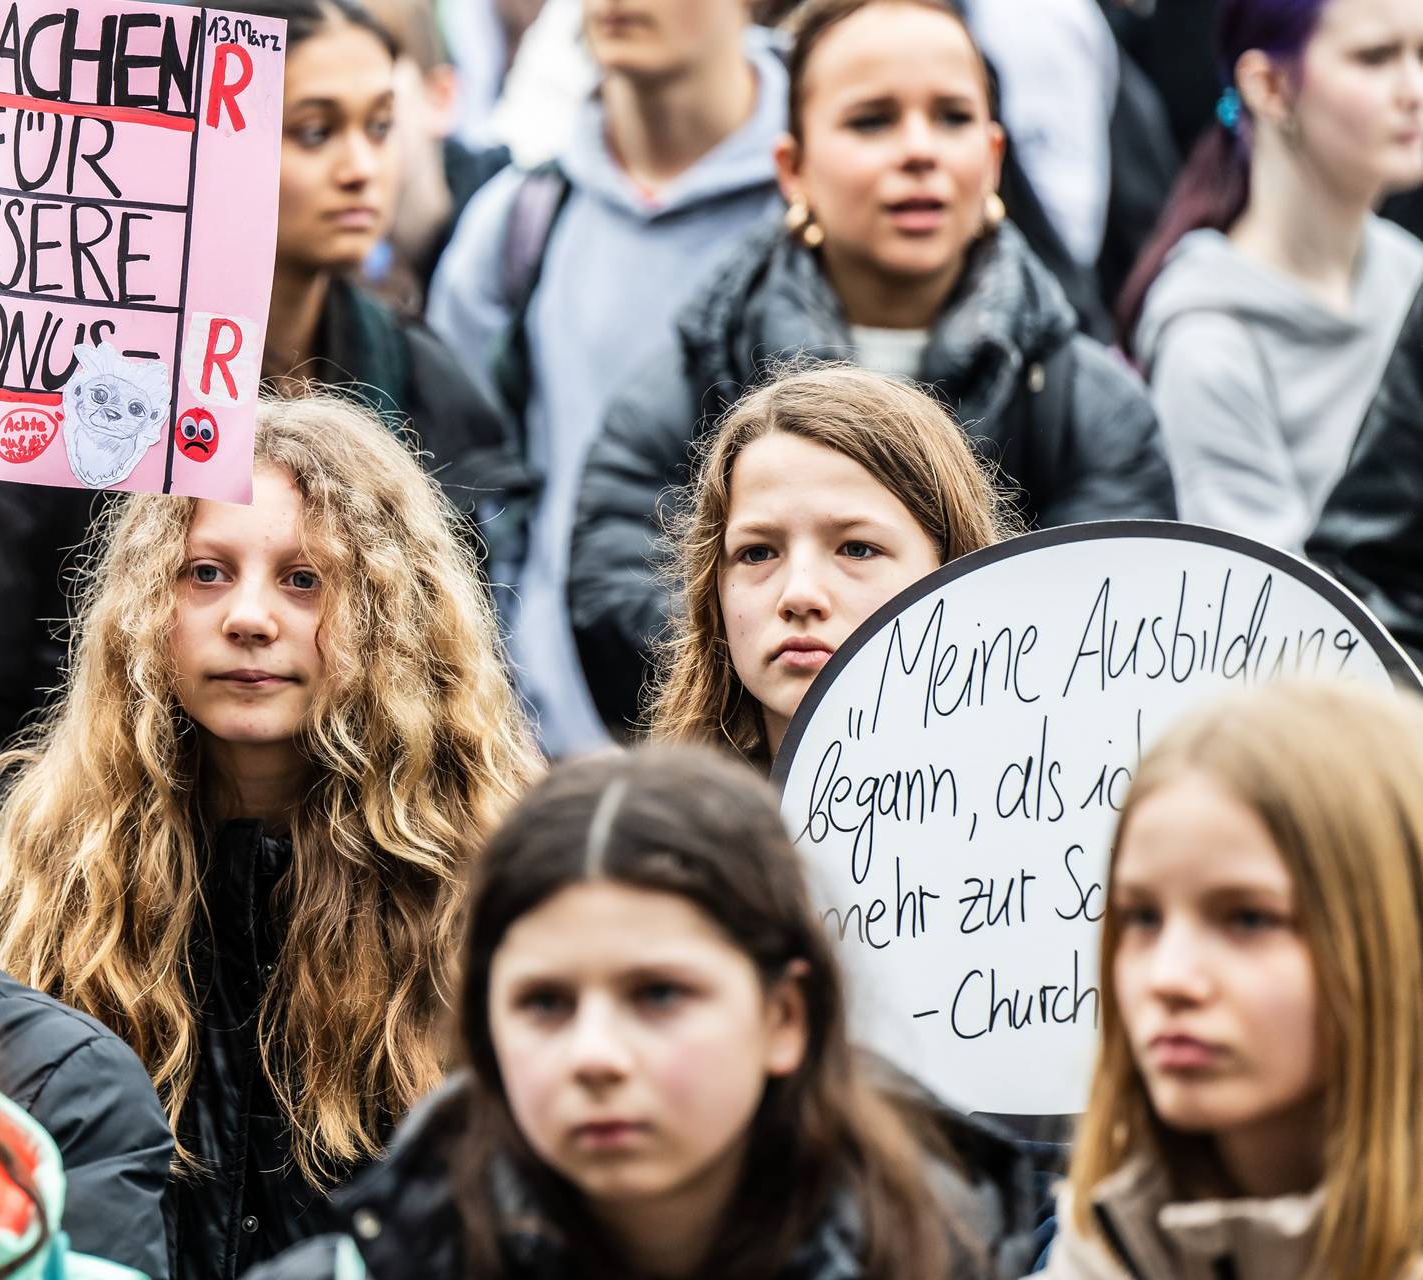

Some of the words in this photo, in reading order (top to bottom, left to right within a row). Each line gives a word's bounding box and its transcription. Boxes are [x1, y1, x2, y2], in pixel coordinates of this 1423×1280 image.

[206, 42, 253, 132] R
[200, 318, 242, 400] R
[4, 415, 46, 433] Achte
[793, 741, 977, 884] begann,
[997, 715, 1065, 822] als
[819, 857, 940, 949] mehr
[959, 869, 1036, 934] zur
